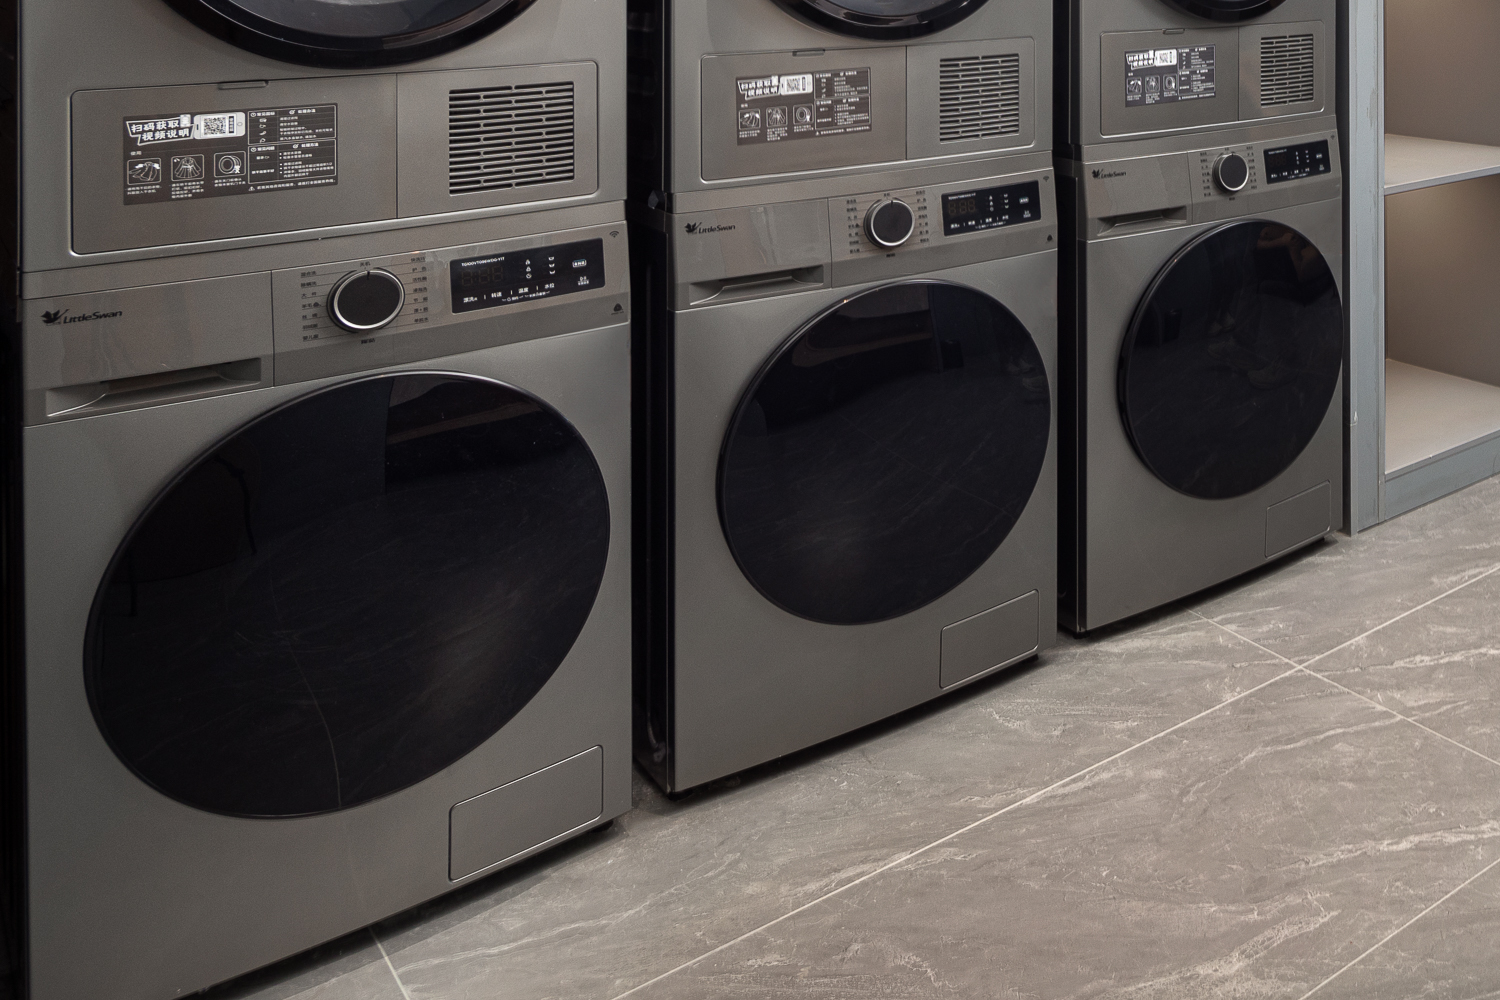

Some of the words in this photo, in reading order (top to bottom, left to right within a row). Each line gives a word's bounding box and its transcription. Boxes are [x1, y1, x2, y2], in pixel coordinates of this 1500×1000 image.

[131, 119, 180, 133] 扫码获取
[141, 128, 190, 141] 视频说明
[698, 224, 736, 234] LittleSwan
[63, 310, 123, 324] LittleSwan
